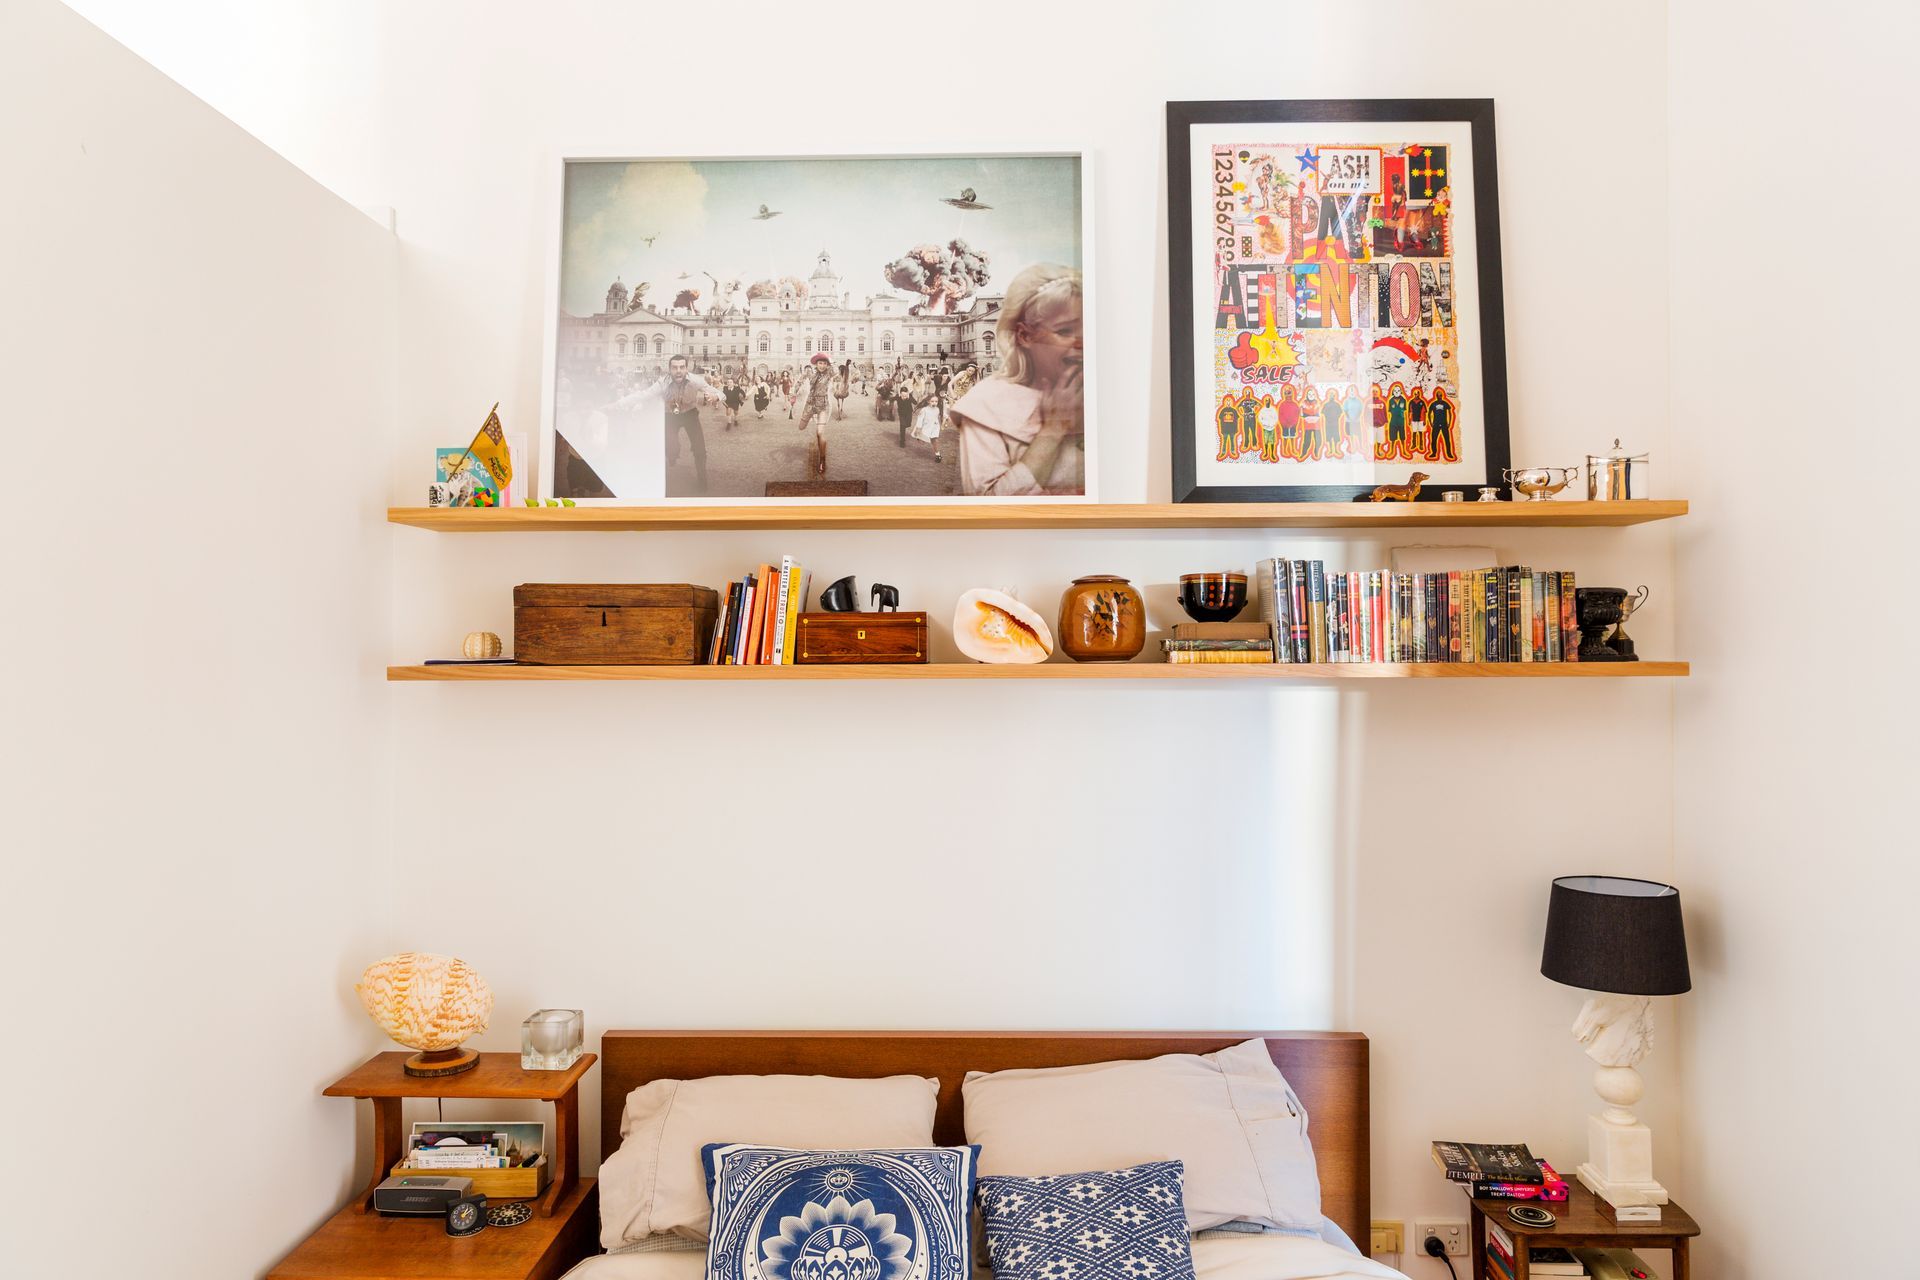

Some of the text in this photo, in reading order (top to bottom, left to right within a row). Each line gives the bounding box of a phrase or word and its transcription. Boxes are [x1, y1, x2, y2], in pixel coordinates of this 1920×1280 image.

[1330, 155, 1370, 180] ASH
[1290, 195, 1370, 260] PAY
[1215, 262, 1453, 329] ATTENTION
[1242, 366, 1293, 383] SALE
[781, 565, 789, 589] MATTER
[778, 599, 786, 618] TRUST
[1452, 1170, 1486, 1181] TEMPLE
[751, 1206, 759, 1218] THAN
[767, 1177, 793, 1197] DISTORTION
[885, 1174, 907, 1190] BETWEEN
[916, 1200, 923, 1208] TO
